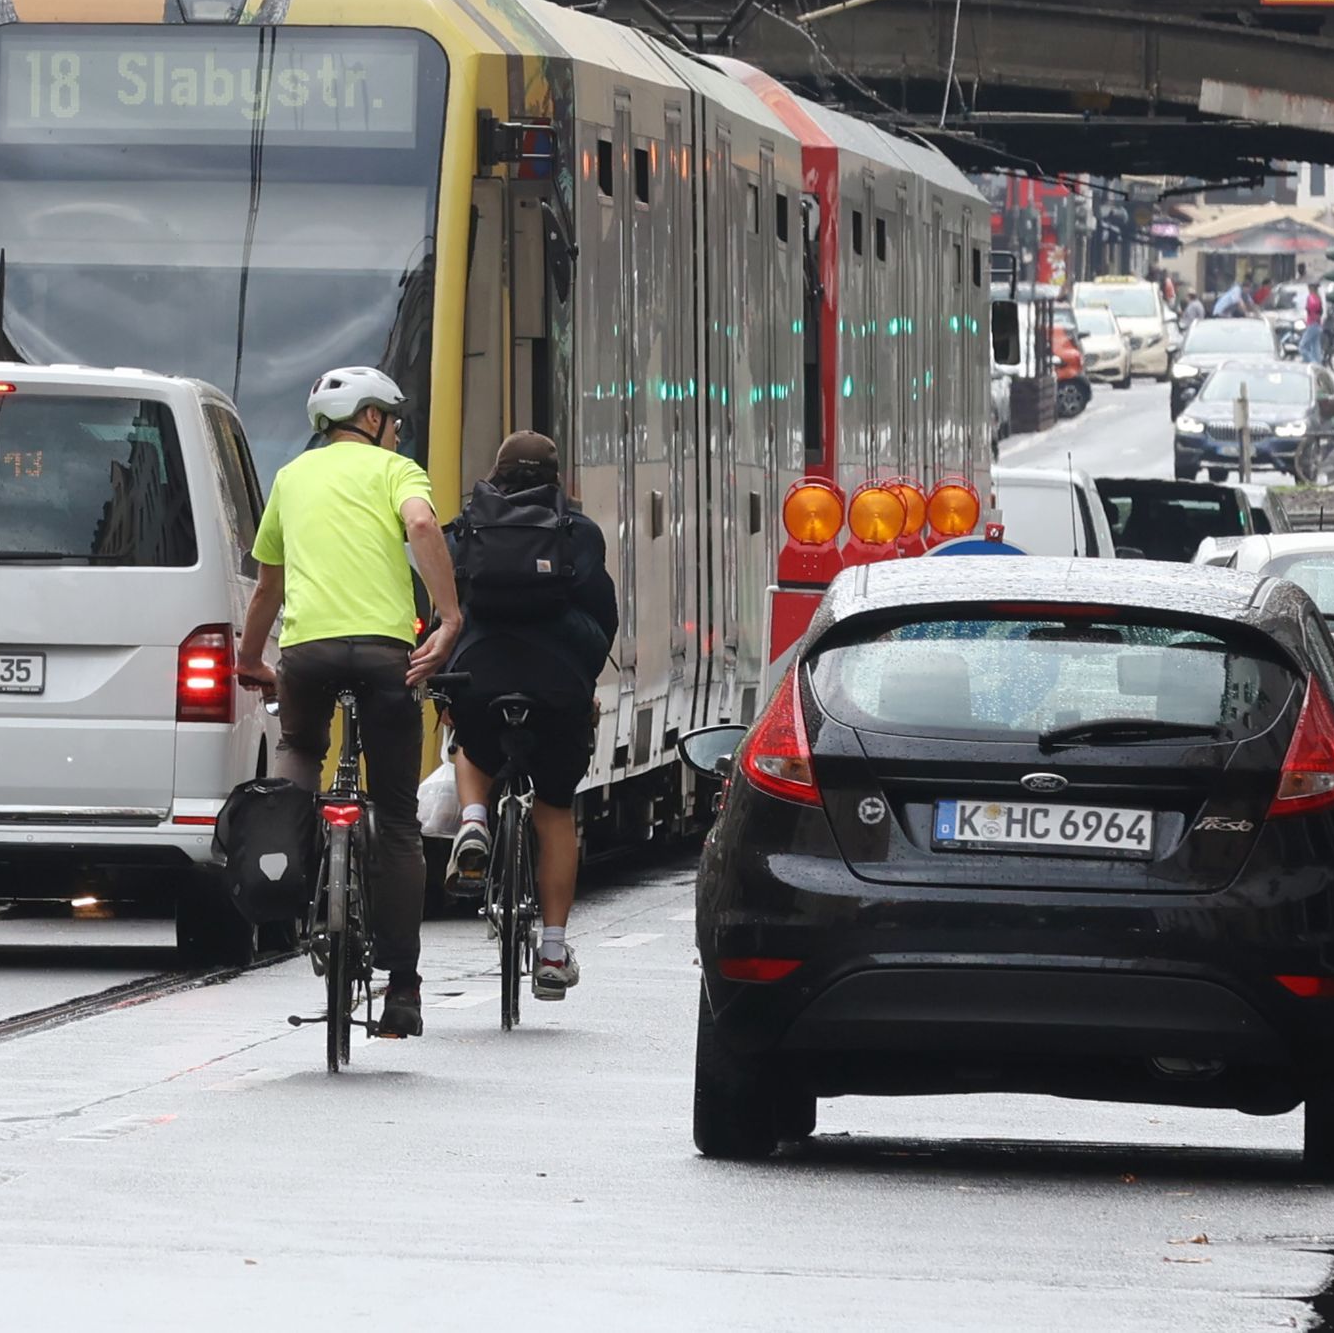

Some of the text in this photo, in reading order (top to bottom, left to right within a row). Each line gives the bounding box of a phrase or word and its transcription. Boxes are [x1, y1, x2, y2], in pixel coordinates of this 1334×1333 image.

[26, 51, 383, 120] 18 Slabystr.
[958, 804, 982, 837] K
[1005, 807, 1051, 840] HC
[1059, 808, 1147, 846] 6964
